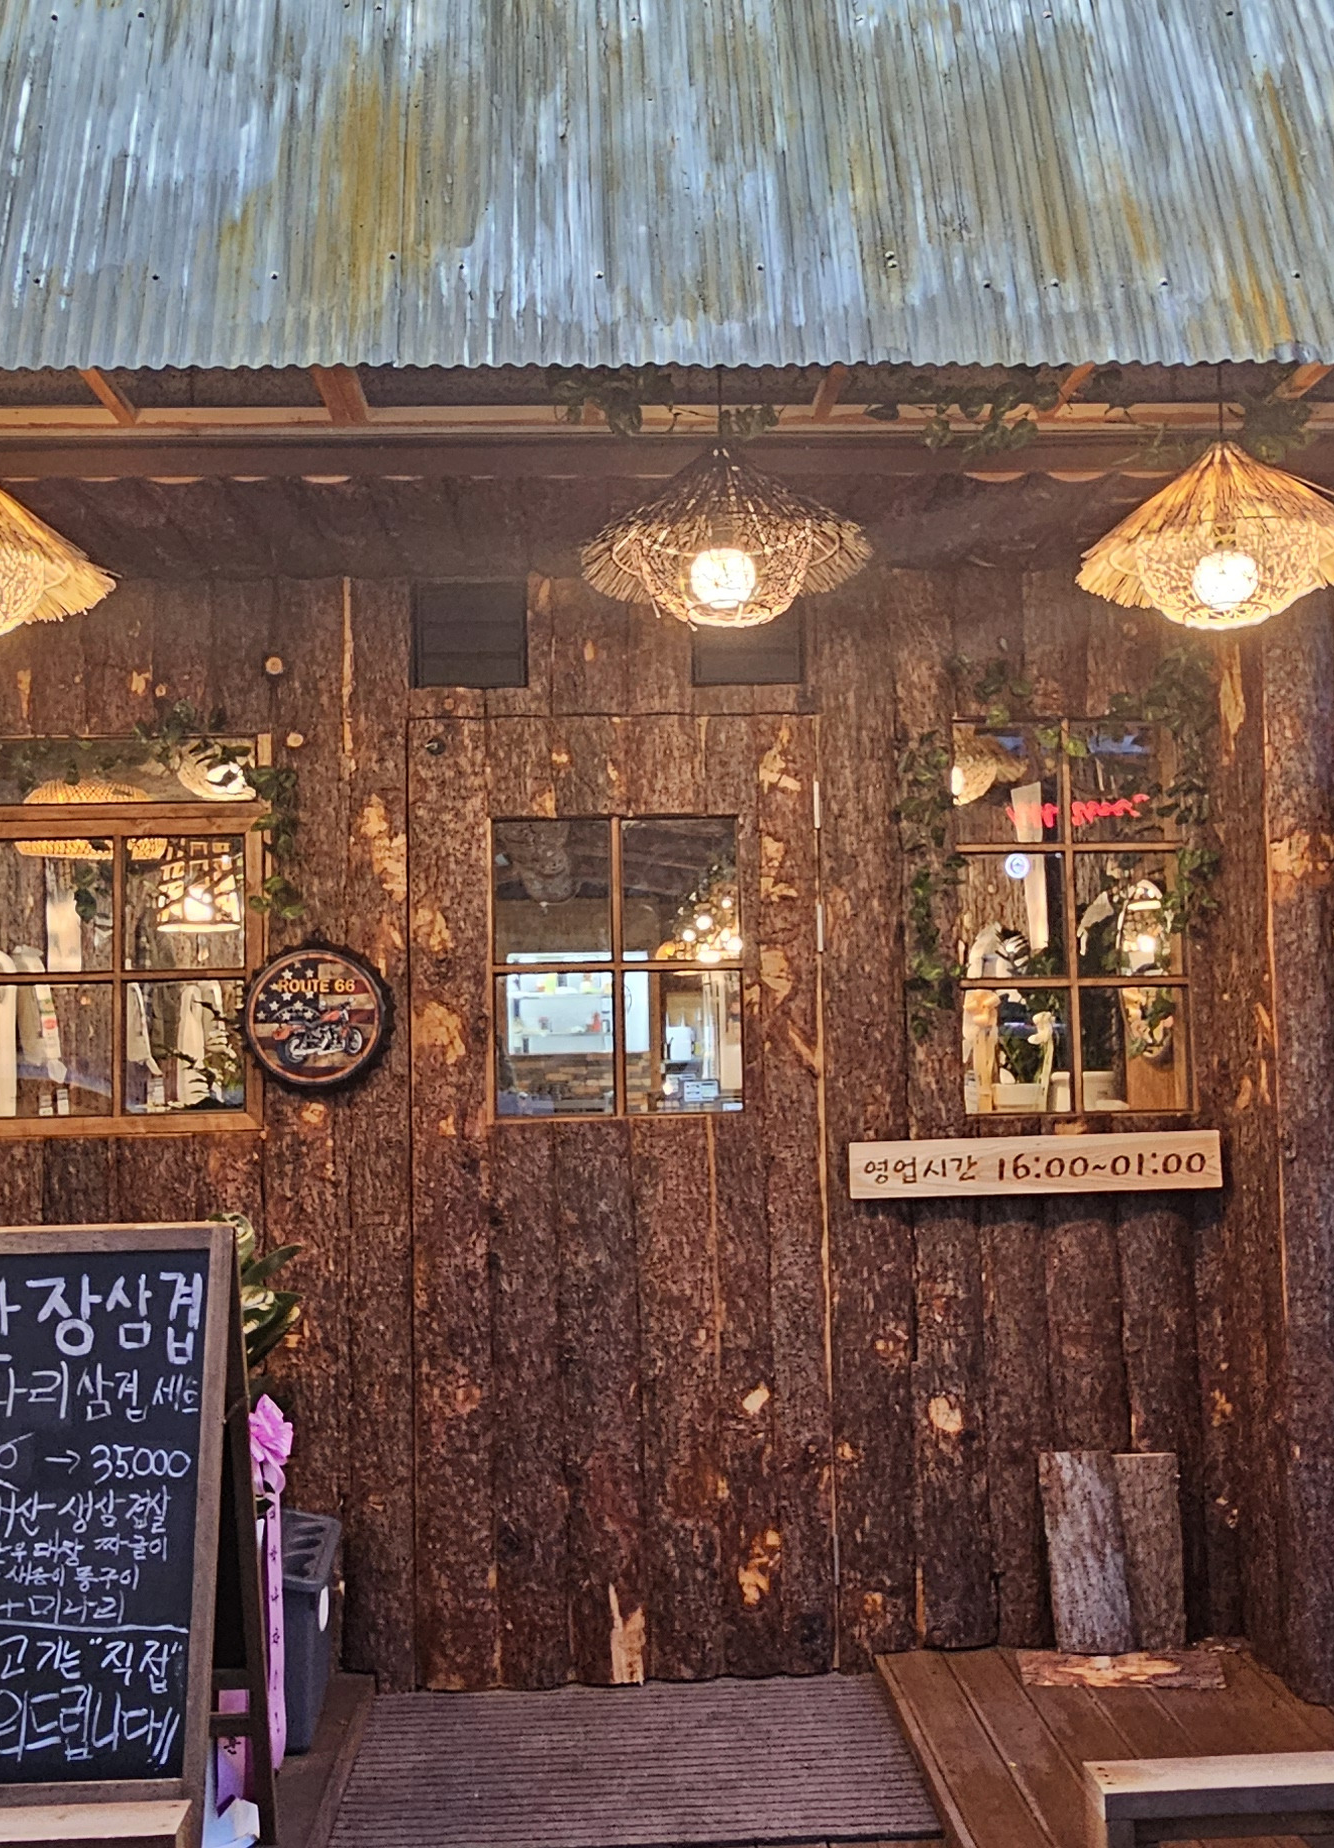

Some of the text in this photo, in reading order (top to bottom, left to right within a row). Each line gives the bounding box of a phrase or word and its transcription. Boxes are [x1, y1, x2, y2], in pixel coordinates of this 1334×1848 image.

[278, 979, 356, 993] ROUTE 66
[864, 1152, 1208, 1185] 영업시간 16:00~01:00
